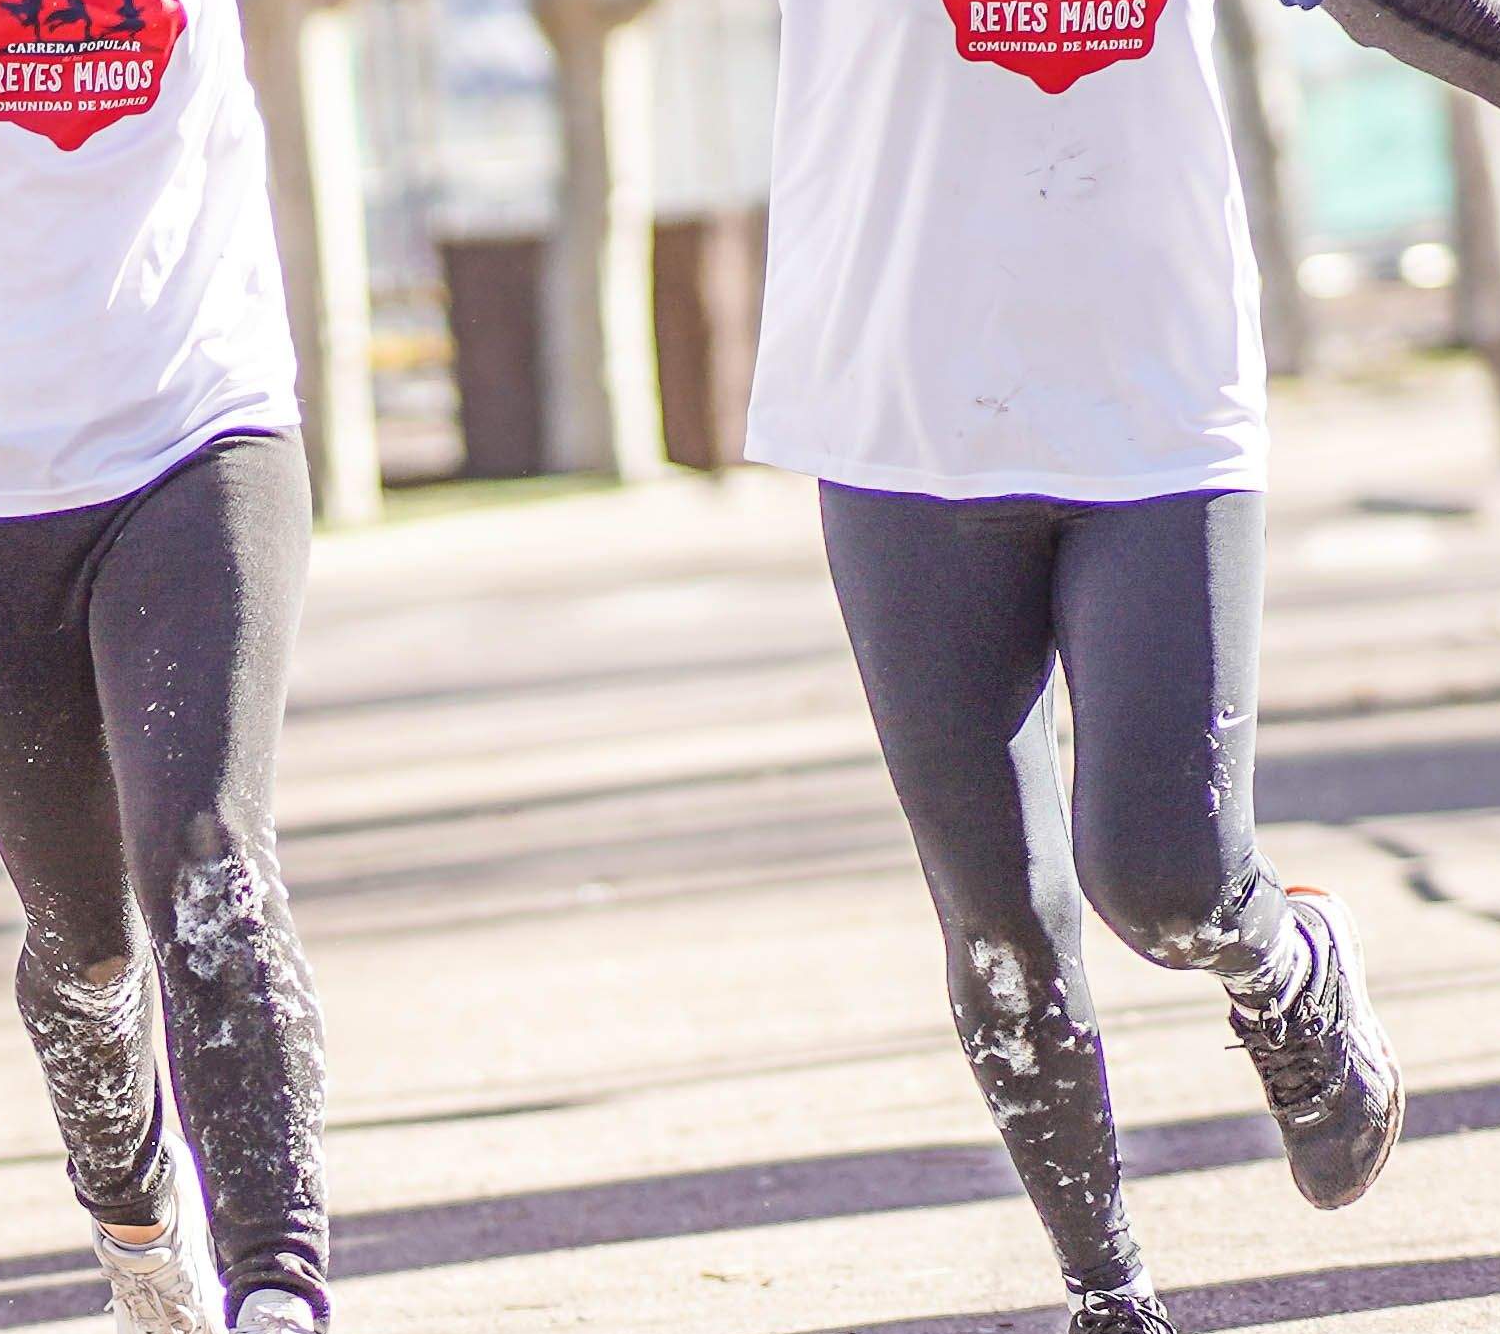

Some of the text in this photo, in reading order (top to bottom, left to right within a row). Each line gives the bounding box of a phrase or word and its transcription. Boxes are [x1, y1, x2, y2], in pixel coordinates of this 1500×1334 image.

[969, 0, 1048, 33] REYES
[7, 40, 141, 54] CARRERA POPULAR
[968, 38, 1143, 52] COMUNIDAD DE MADRID
[73, 59, 153, 93] MAGOS
[78, 100, 97, 112] DE
[99, 96, 148, 111] MADRID
